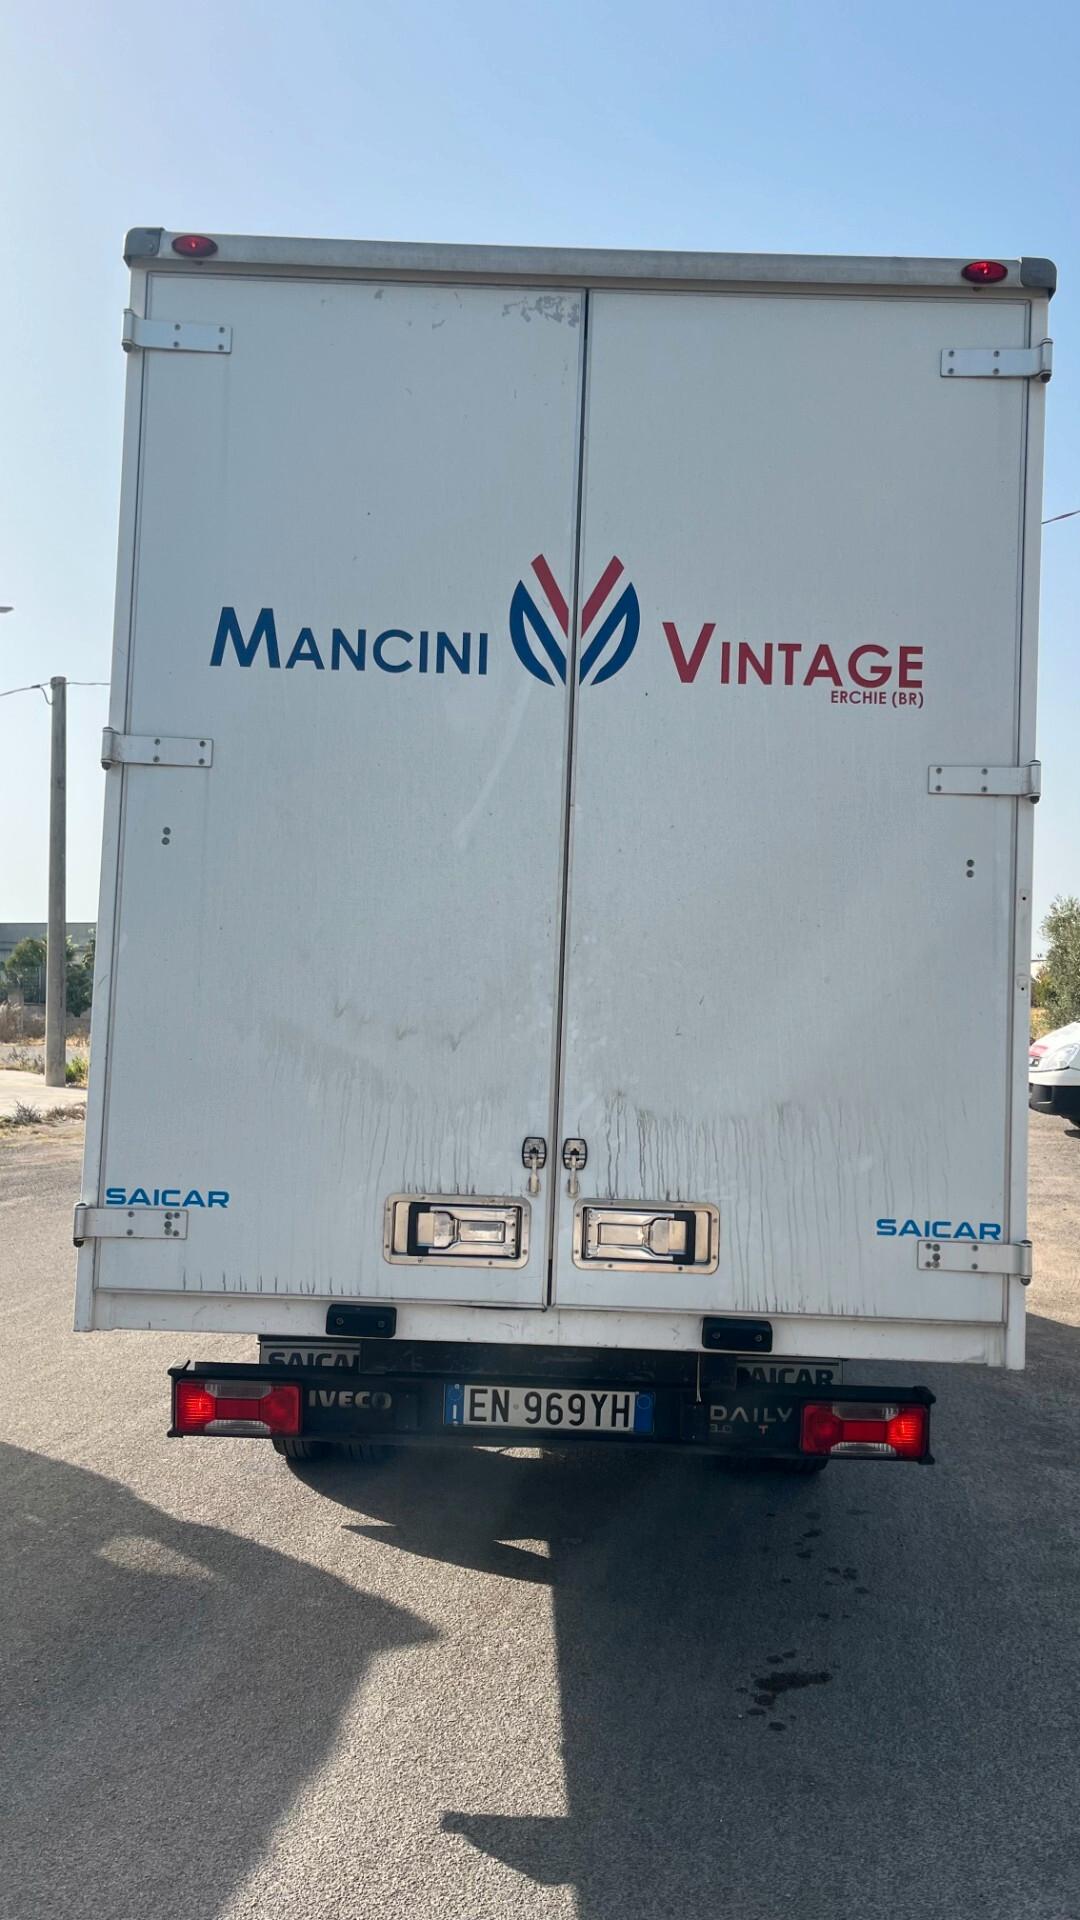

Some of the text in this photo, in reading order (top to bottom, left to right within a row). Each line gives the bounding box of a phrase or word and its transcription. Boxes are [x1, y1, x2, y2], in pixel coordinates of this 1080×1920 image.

[209, 605, 489, 675] MANCINI
[661, 621, 925, 689] VINTAGE
[830, 690, 925, 709] ERCHIE (BR)
[105, 1186, 231, 1209] SAICAR
[875, 1217, 1002, 1241] SAICAR
[307, 1389, 393, 1409] IVECO
[469, 1388, 631, 1428] EN 969YH
[709, 1404, 793, 1423] DAILY
